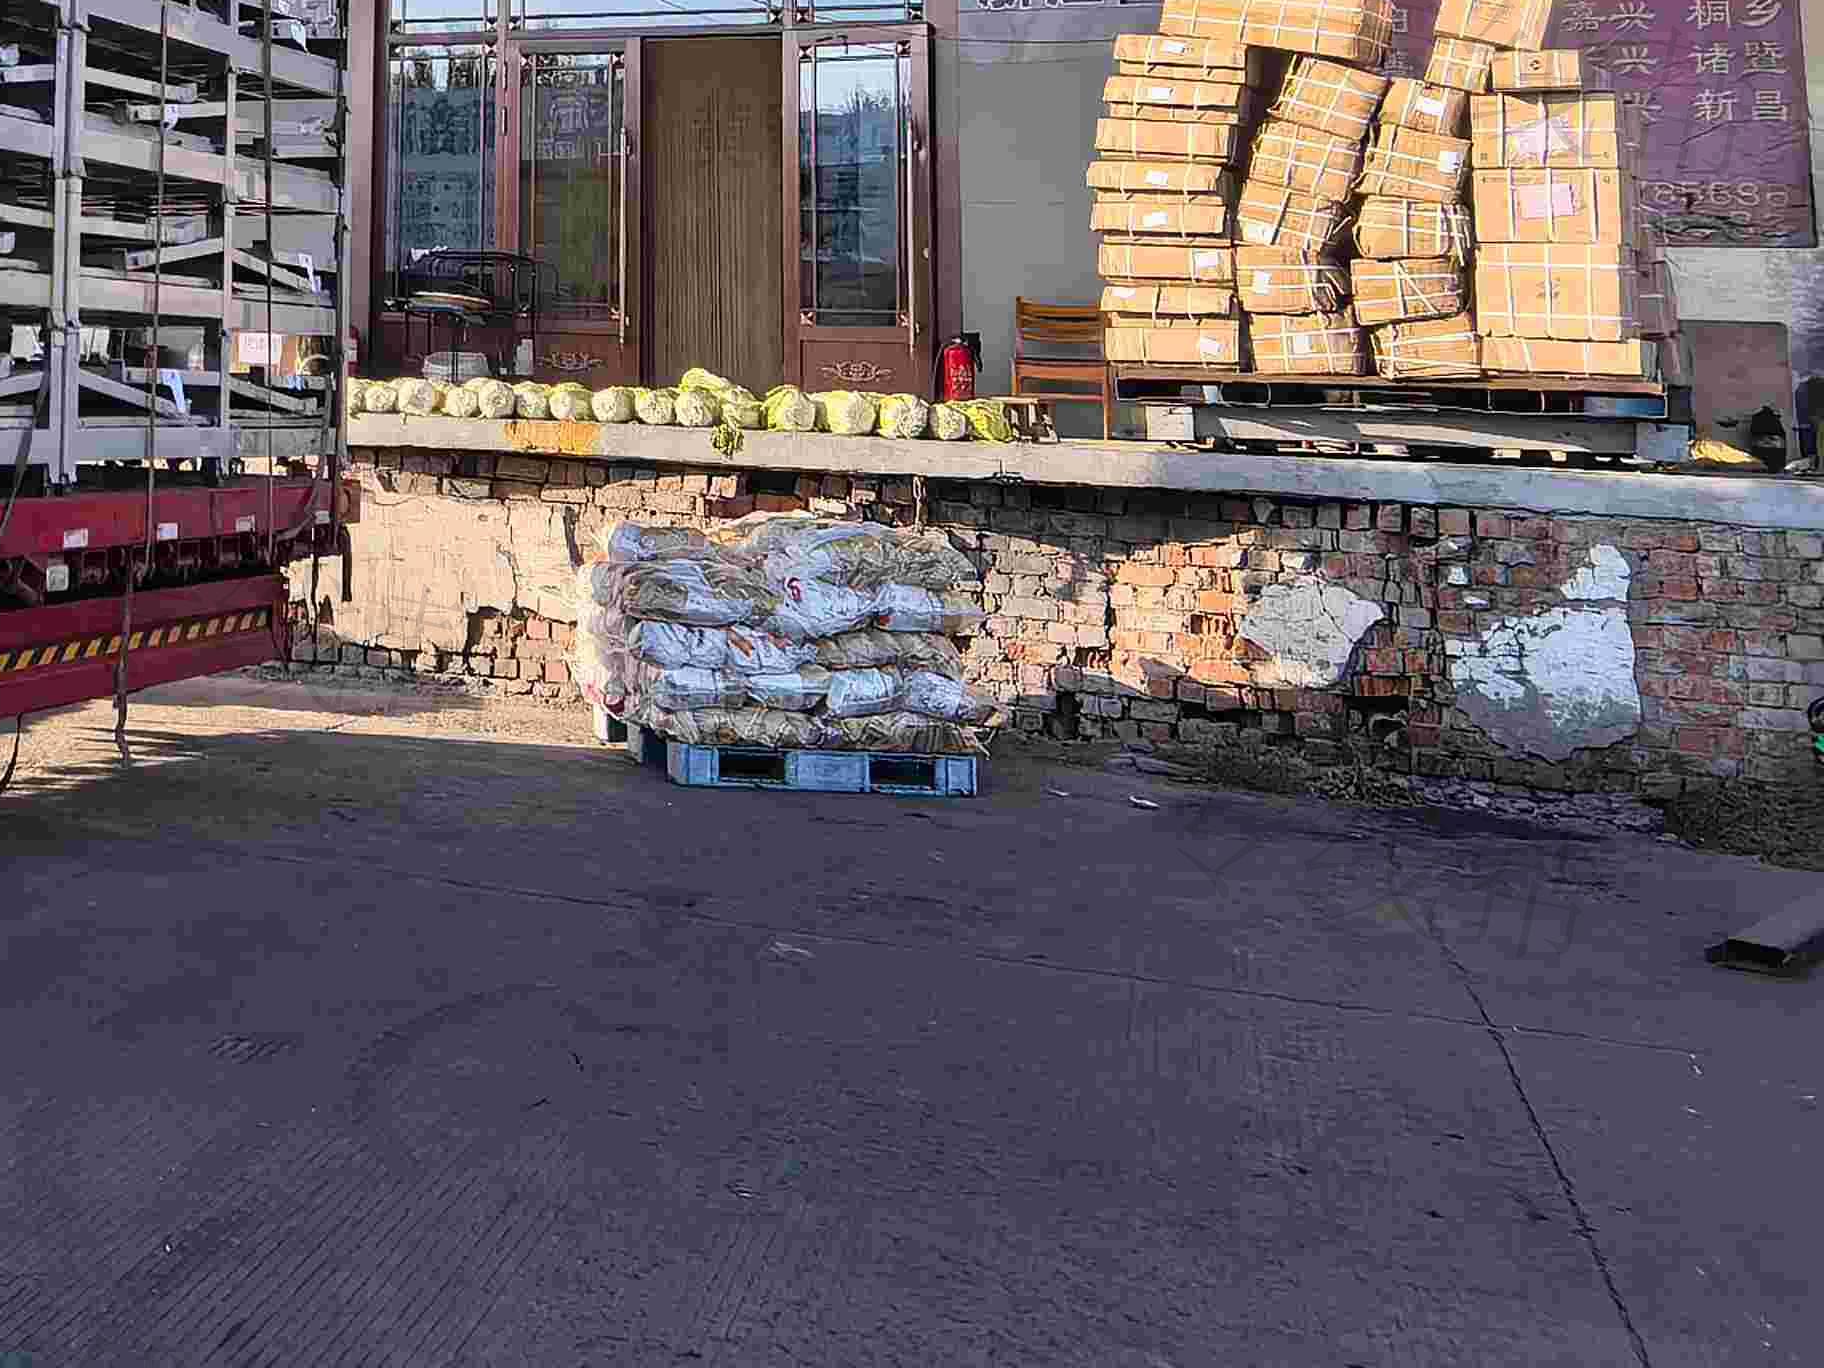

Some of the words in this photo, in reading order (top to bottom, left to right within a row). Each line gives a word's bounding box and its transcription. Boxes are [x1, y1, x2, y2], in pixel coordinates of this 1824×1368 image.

[1559, 0, 1656, 33] 嘉兴
[1687, 40, 1787, 76] 诸暨
[1693, 88, 1789, 122] 新昌
